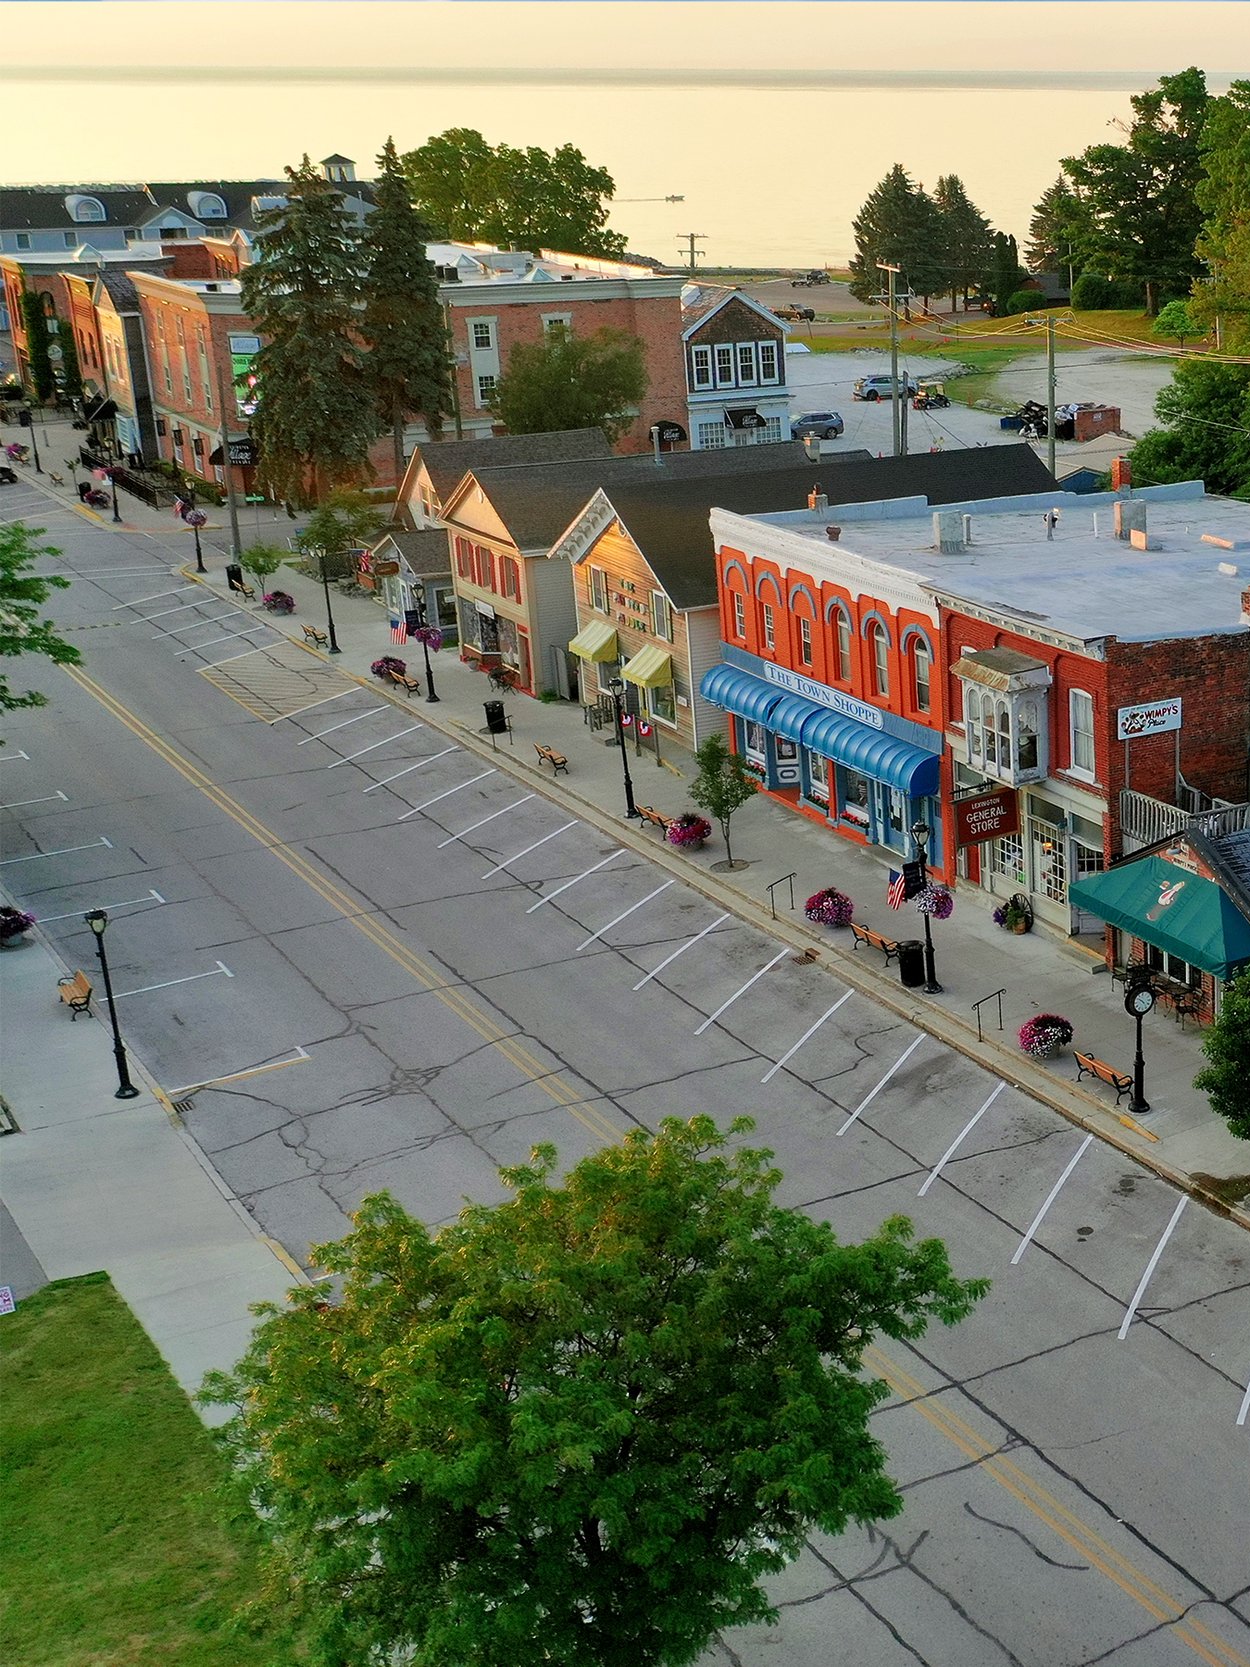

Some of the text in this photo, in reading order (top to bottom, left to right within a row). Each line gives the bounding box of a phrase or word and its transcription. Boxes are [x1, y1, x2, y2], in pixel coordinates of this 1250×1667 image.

[768, 666, 879, 725] THE TOWN SHOPPE
[1145, 704, 1179, 720] WIMPY'S
[971, 798, 1000, 810] LEXINGTON
[966, 805, 1007, 823] GENERAL
[970, 818, 1001, 834] STORE
